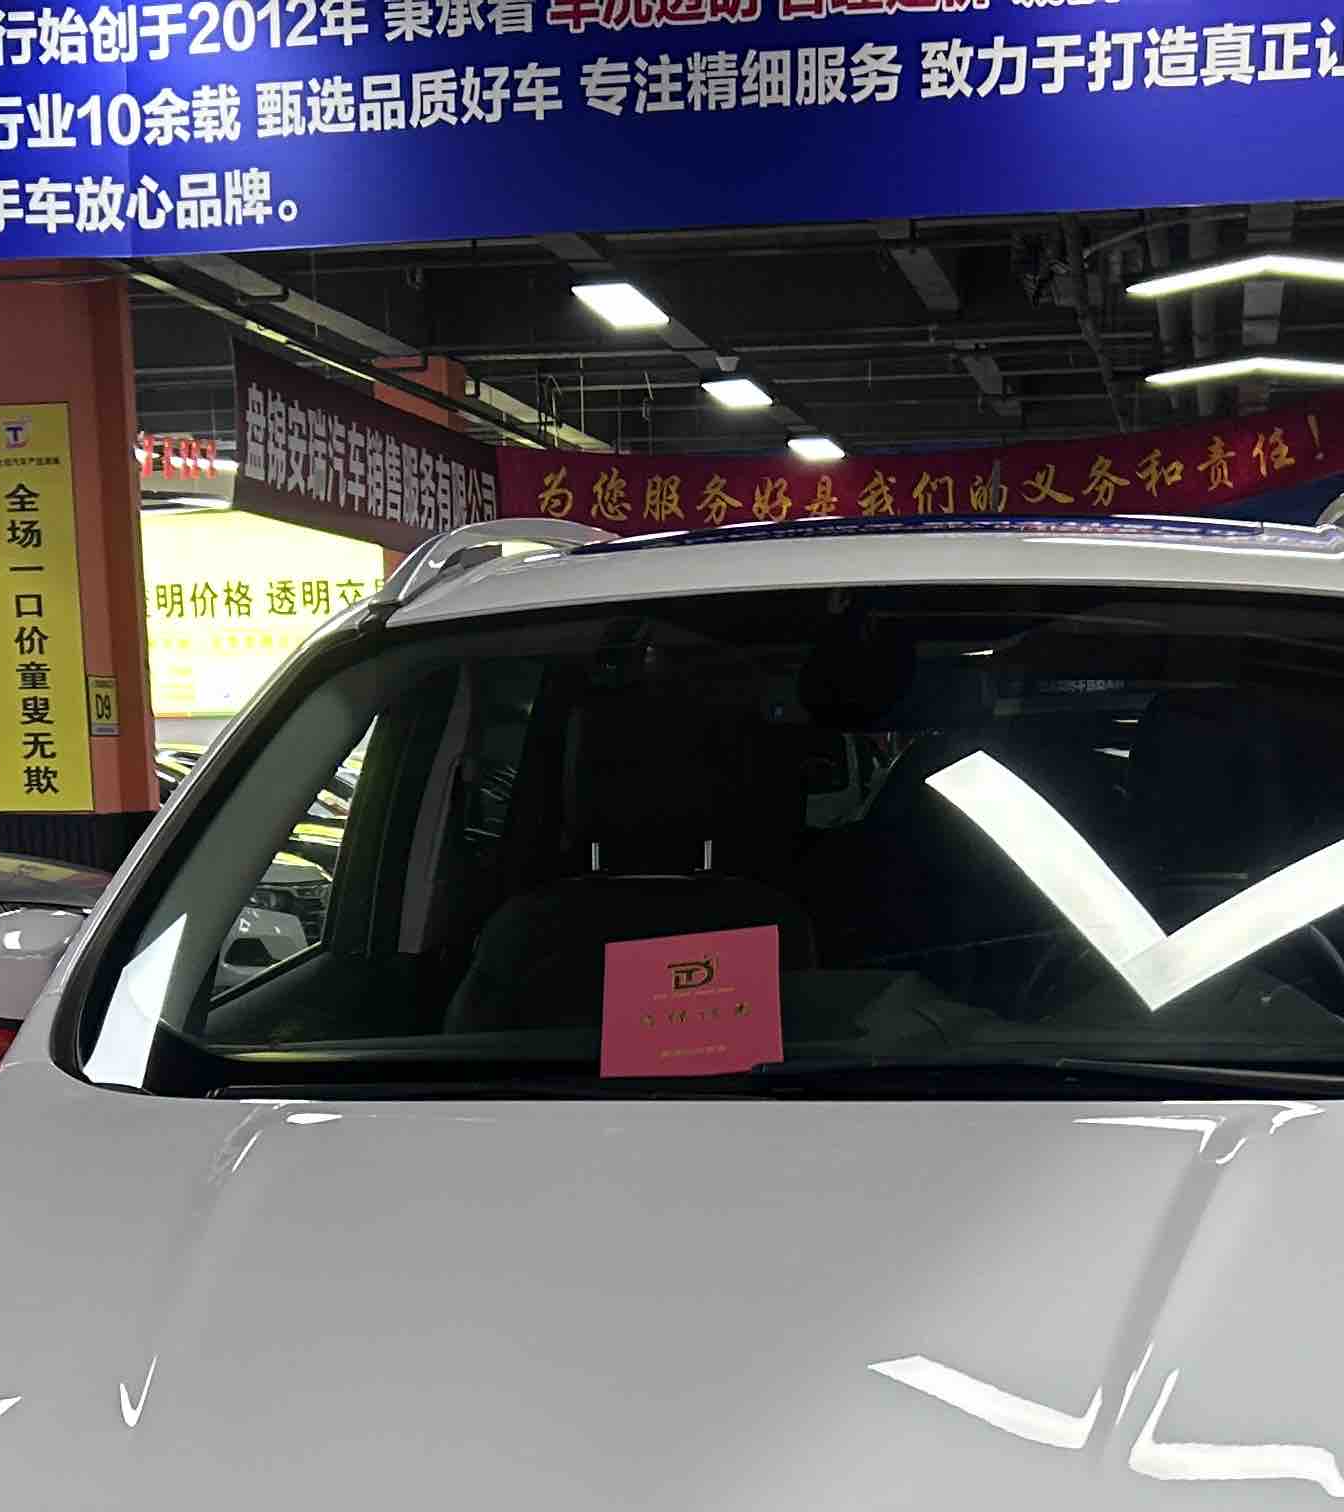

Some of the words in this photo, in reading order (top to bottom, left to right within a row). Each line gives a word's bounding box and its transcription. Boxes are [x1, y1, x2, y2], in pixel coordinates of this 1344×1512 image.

[255, 63, 563, 139] 甄选品质好车
[580, 43, 903, 117] 专注精细服务
[145, 578, 253, 618] 明价格
[4, 483, 60, 795] 全场一口价童叟无欺
[95, 693, 113, 720] D9
